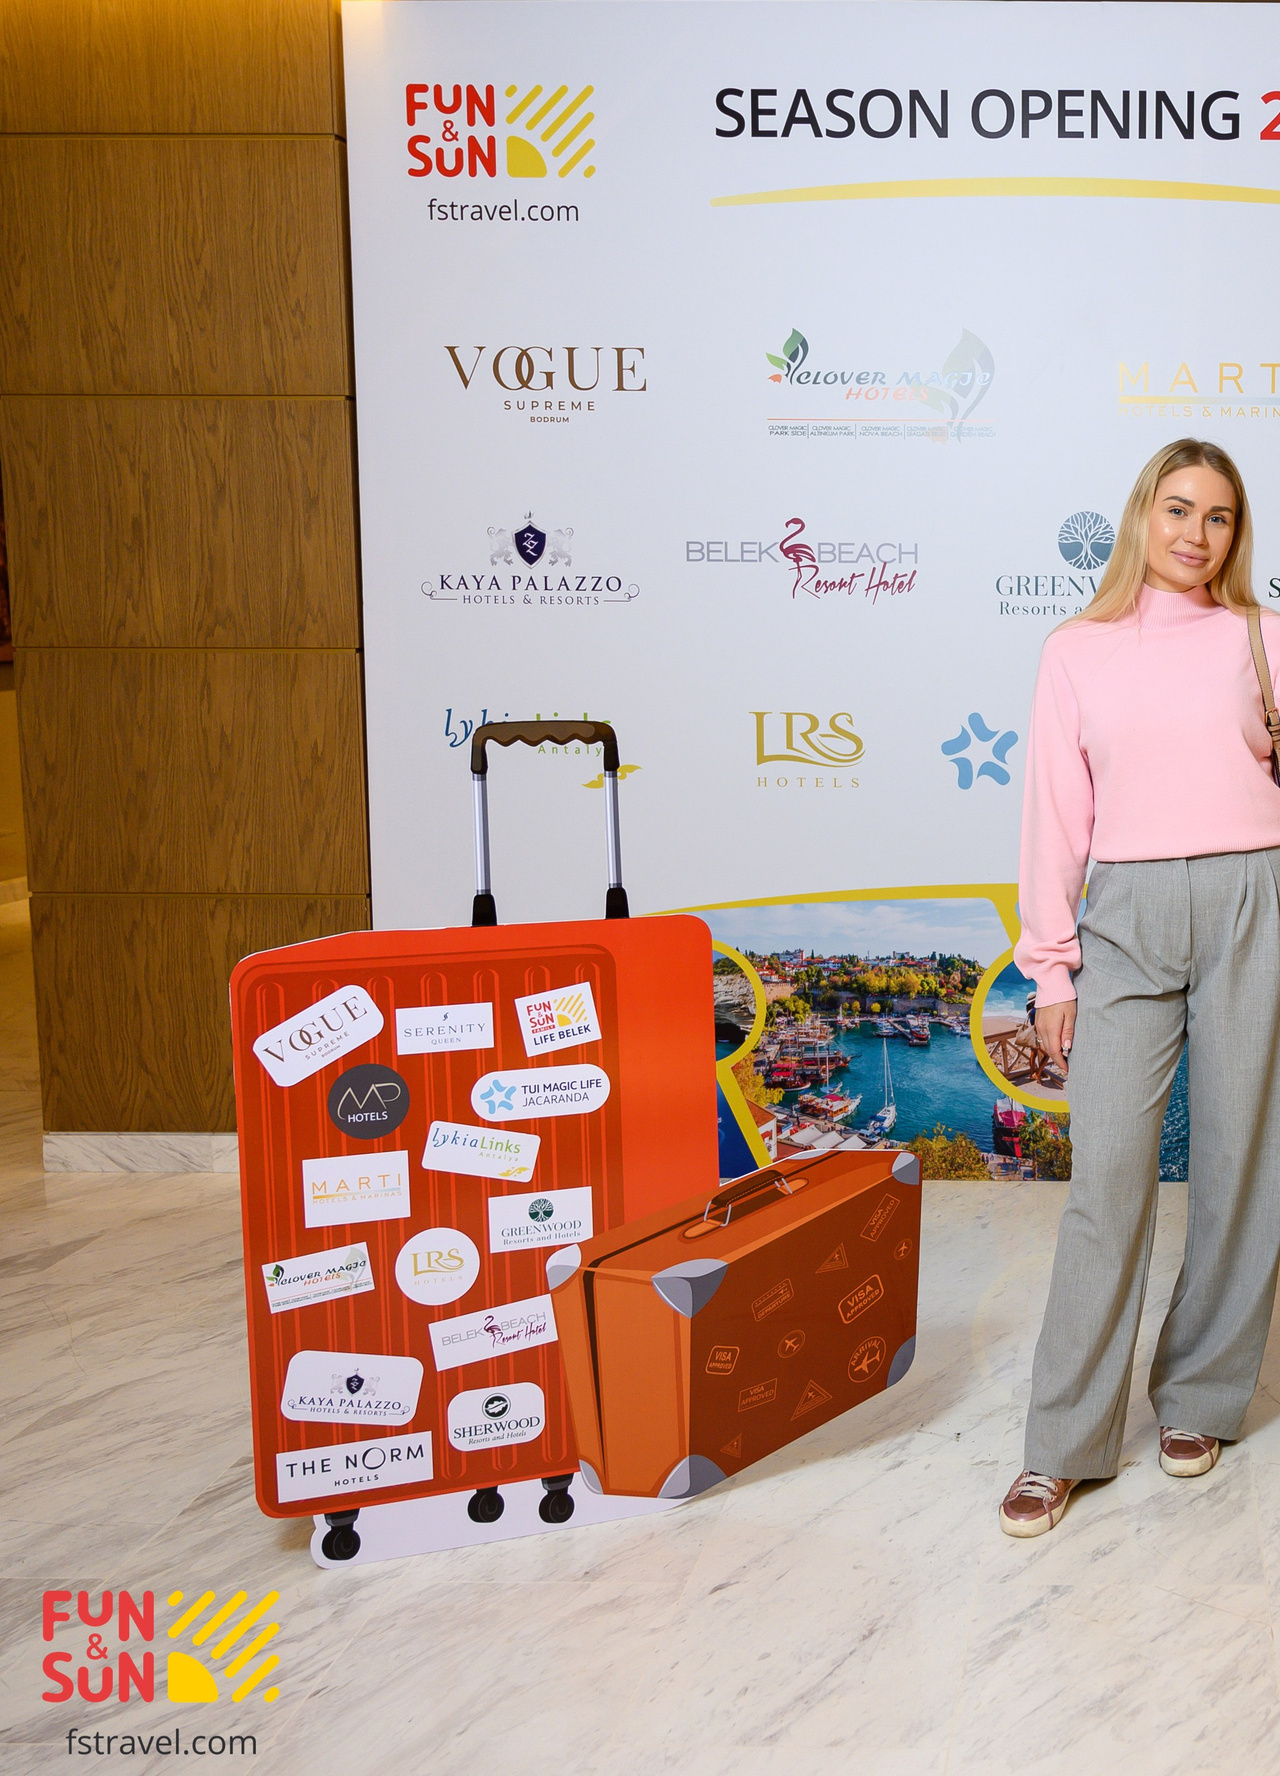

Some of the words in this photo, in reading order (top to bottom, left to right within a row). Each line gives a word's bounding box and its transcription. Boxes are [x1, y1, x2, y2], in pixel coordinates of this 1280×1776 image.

[406, 83, 497, 127] FUN
[714, 87, 950, 140] SEASON
[970, 88, 1241, 142] OPENING
[441, 119, 460, 142] &
[406, 134, 497, 178] SUN
[427, 197, 580, 222] fstravel.com
[444, 345, 647, 393] VOGUE
[796, 370, 886, 386] CLOVER
[895, 370, 991, 389] MAGIC
[845, 386, 930, 401] HOTELS
[503, 400, 597, 412] SUPREME
[1118, 405, 1193, 418] HOTELS
[1202, 406, 1213, 418] &
[685, 540, 780, 563] BELEK
[817, 542, 919, 564] BEACH
[439, 574, 502, 591] KAYA
[510, 575, 622, 592] PALAZZO
[788, 563, 865, 600] Resort
[865, 561, 918, 606] Hotel
[995, 574, 1098, 597] GREEN
[462, 594, 516, 605] HOTELS
[522, 594, 533, 605] &
[539, 595, 600, 606] RESORTS
[999, 600, 1067, 616] Resorts
[748, 711, 867, 769] LRS
[537, 744, 602, 757] Antaly
[756, 777, 860, 788] HOTELS
[526, 1000, 552, 1016] FUN
[262, 995, 368, 1063] VOGUE
[404, 1022, 487, 1038] SERENITY
[529, 1013, 555, 1028] SUN
[431, 1037, 462, 1046] QUEEN
[533, 1033, 556, 1046] LIFE
[558, 1024, 592, 1040] BELEK
[304, 1030, 350, 1061] SUPREME
[521, 1083, 541, 1095] TUI
[543, 1080, 578, 1092] MAGIC
[580, 1078, 603, 1090] LIFE
[522, 1092, 590, 1108] JACARANDA
[347, 1111, 389, 1124] HOTELS
[478, 1150, 519, 1162] Antalya
[312, 1173, 402, 1195] MARTI
[869, 1207, 884, 1228] VISA
[501, 1219, 583, 1239] GREENWOOD
[502, 1235, 535, 1247] Resorts
[536, 1233, 552, 1243] and
[554, 1230, 581, 1242] Hotels
[411, 1248, 466, 1276] LRS
[280, 1271, 321, 1286] CLOVER
[325, 1260, 367, 1275] MAGIC
[413, 1275, 464, 1287] HOTELS
[846, 1283, 874, 1309] VISA
[846, 1288, 881, 1320] APPROVED
[441, 1327, 485, 1347] BELEK
[500, 1312, 547, 1331] BEACH
[714, 1350, 732, 1361] VISA
[850, 1338, 882, 1367] ARRIVAL
[298, 1395, 335, 1407] KAYA
[338, 1398, 402, 1411] PALAZZO
[309, 1407, 341, 1415] HOTELS
[353, 1408, 388, 1417] RESORTS
[453, 1415, 541, 1440] SHERWOOD
[467, 1435, 490, 1446] Resorts
[491, 1432, 505, 1442] and
[506, 1429, 527, 1440] Hotels
[285, 1457, 332, 1478] THE
[344, 1443, 426, 1471] NORM
[333, 1473, 380, 1487] HOTELS
